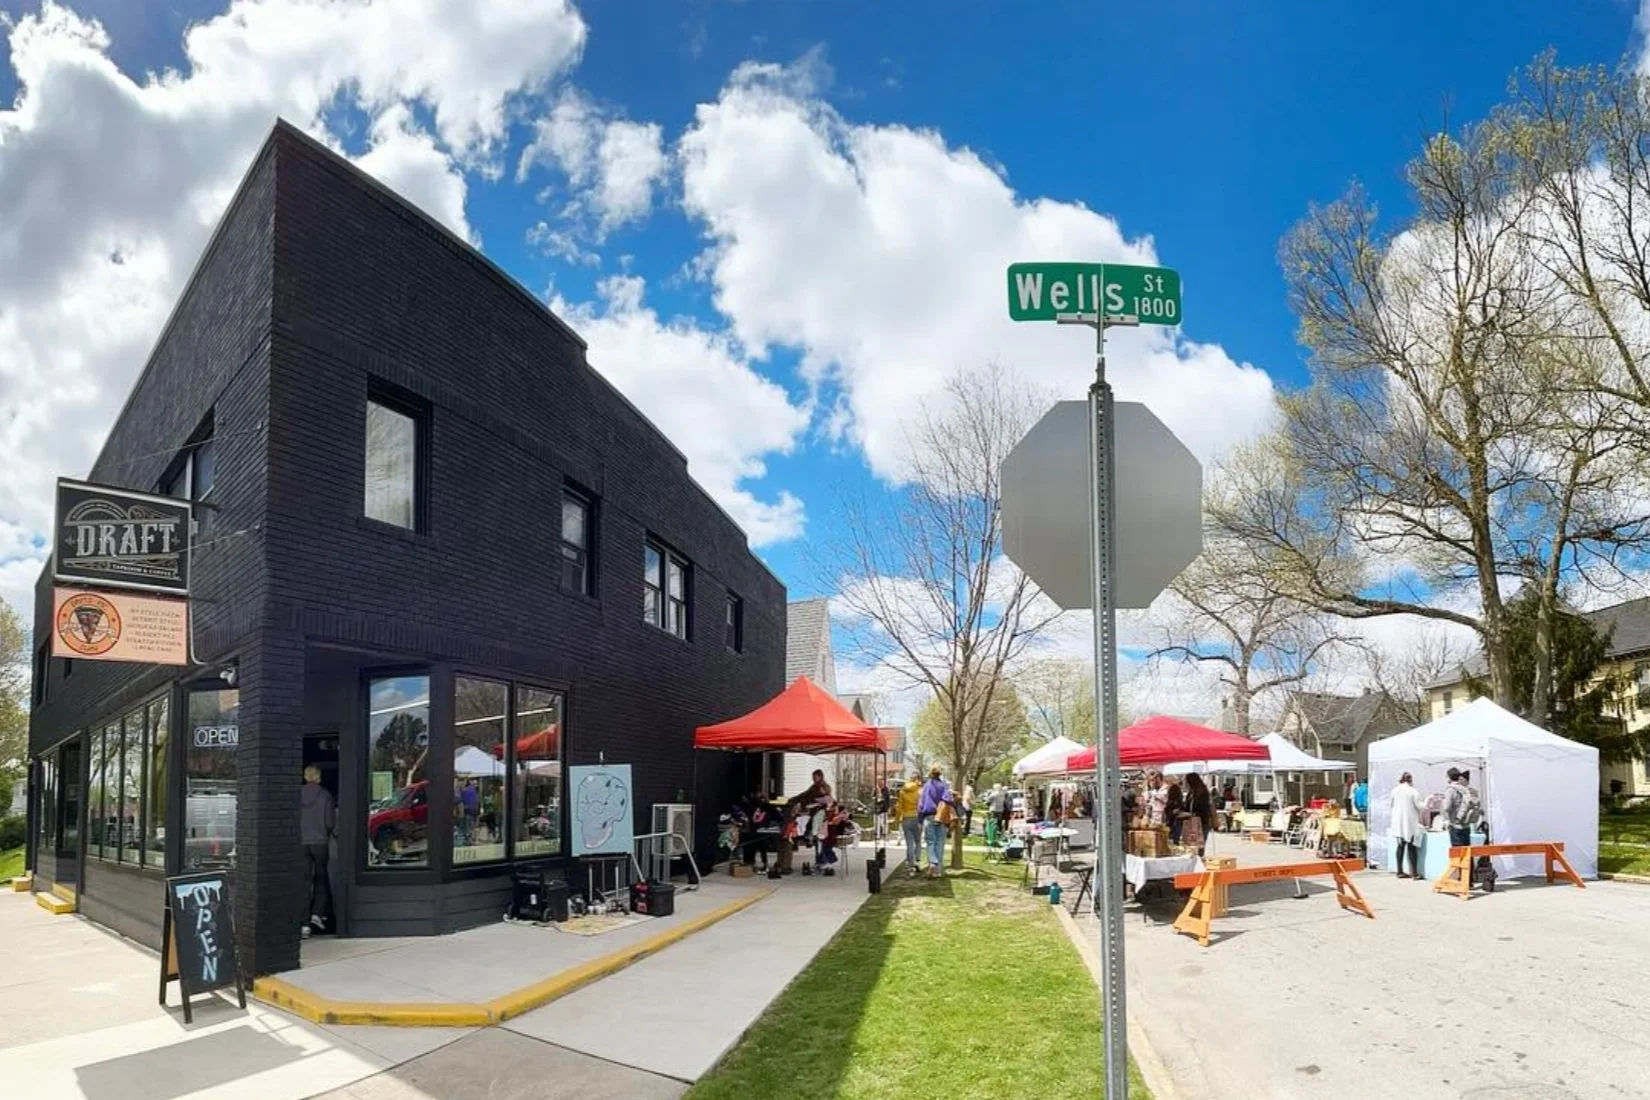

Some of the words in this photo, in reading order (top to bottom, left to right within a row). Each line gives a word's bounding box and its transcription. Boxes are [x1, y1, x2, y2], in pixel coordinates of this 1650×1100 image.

[1015, 273, 1125, 311] Wells
[1143, 274, 1164, 293] St
[1134, 297, 1176, 318] 1800
[76, 523, 175, 558] DRAFT
[196, 729, 239, 745] OPEN
[194, 886, 217, 981] OPEN
